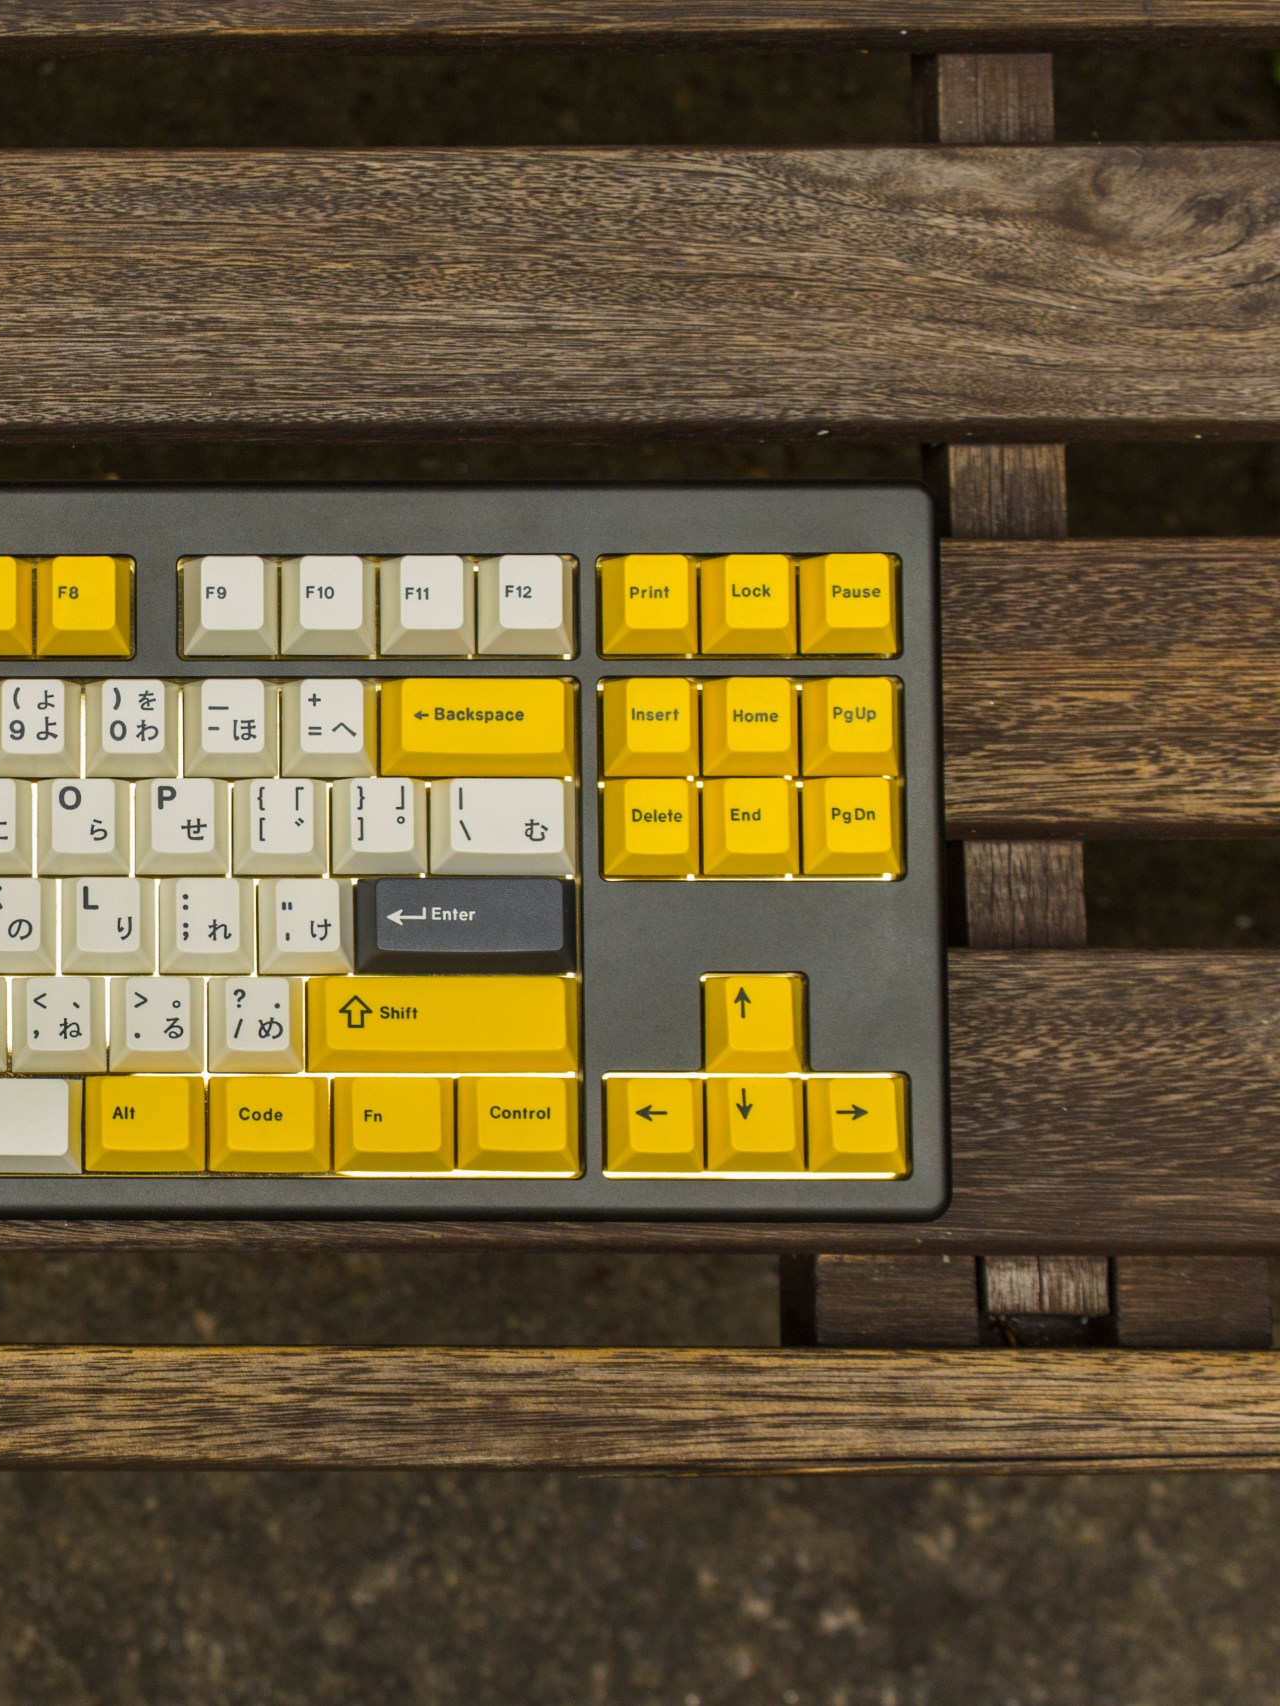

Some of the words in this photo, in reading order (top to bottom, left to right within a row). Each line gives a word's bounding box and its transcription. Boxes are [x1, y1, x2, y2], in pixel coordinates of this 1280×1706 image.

[58, 586, 79, 600] F8
[205, 586, 227, 600] F9
[305, 585, 335, 600] F10
[405, 587, 429, 601] F11
[505, 584, 532, 599] F12
[630, 586, 669, 599] Print
[732, 584, 771, 598] Lock
[832, 585, 881, 598] Pause
[138, 690, 157, 711] を
[307, 693, 322, 707] +
[434, 707, 525, 723] Backspace
[632, 708, 679, 721] Insert
[733, 710, 778, 723] Home
[9, 719, 26, 741] 9
[36, 716, 58, 741] よ
[109, 719, 127, 742] 0
[135, 719, 159, 742] わ
[233, 719, 257, 741] ほ
[308, 726, 322, 736] =
[331, 722, 357, 737] へ
[58, 785, 82, 811] O
[157, 785, 177, 810] P
[632, 808, 683, 823] Delete
[730, 808, 761, 821] End
[89, 818, 108, 842] ら
[180, 818, 208, 841] せ
[524, 818, 549, 842] む
[82, 885, 100, 911] L
[431, 906, 477, 922] Enter
[7, 918, 33, 941] の
[117, 916, 133, 941] り
[207, 918, 233, 942] れ
[310, 918, 332, 942] け
[233, 988, 246, 1009] ?
[379, 1006, 418, 1020] Shift
[58, 1017, 83, 1040] ね
[163, 1017, 184, 1040] る
[258, 1017, 284, 1040] め
[112, 1106, 136, 1120] Alt
[238, 1107, 283, 1122] Code
[364, 1109, 383, 1122] Fn
[489, 1105, 551, 1120] Control
